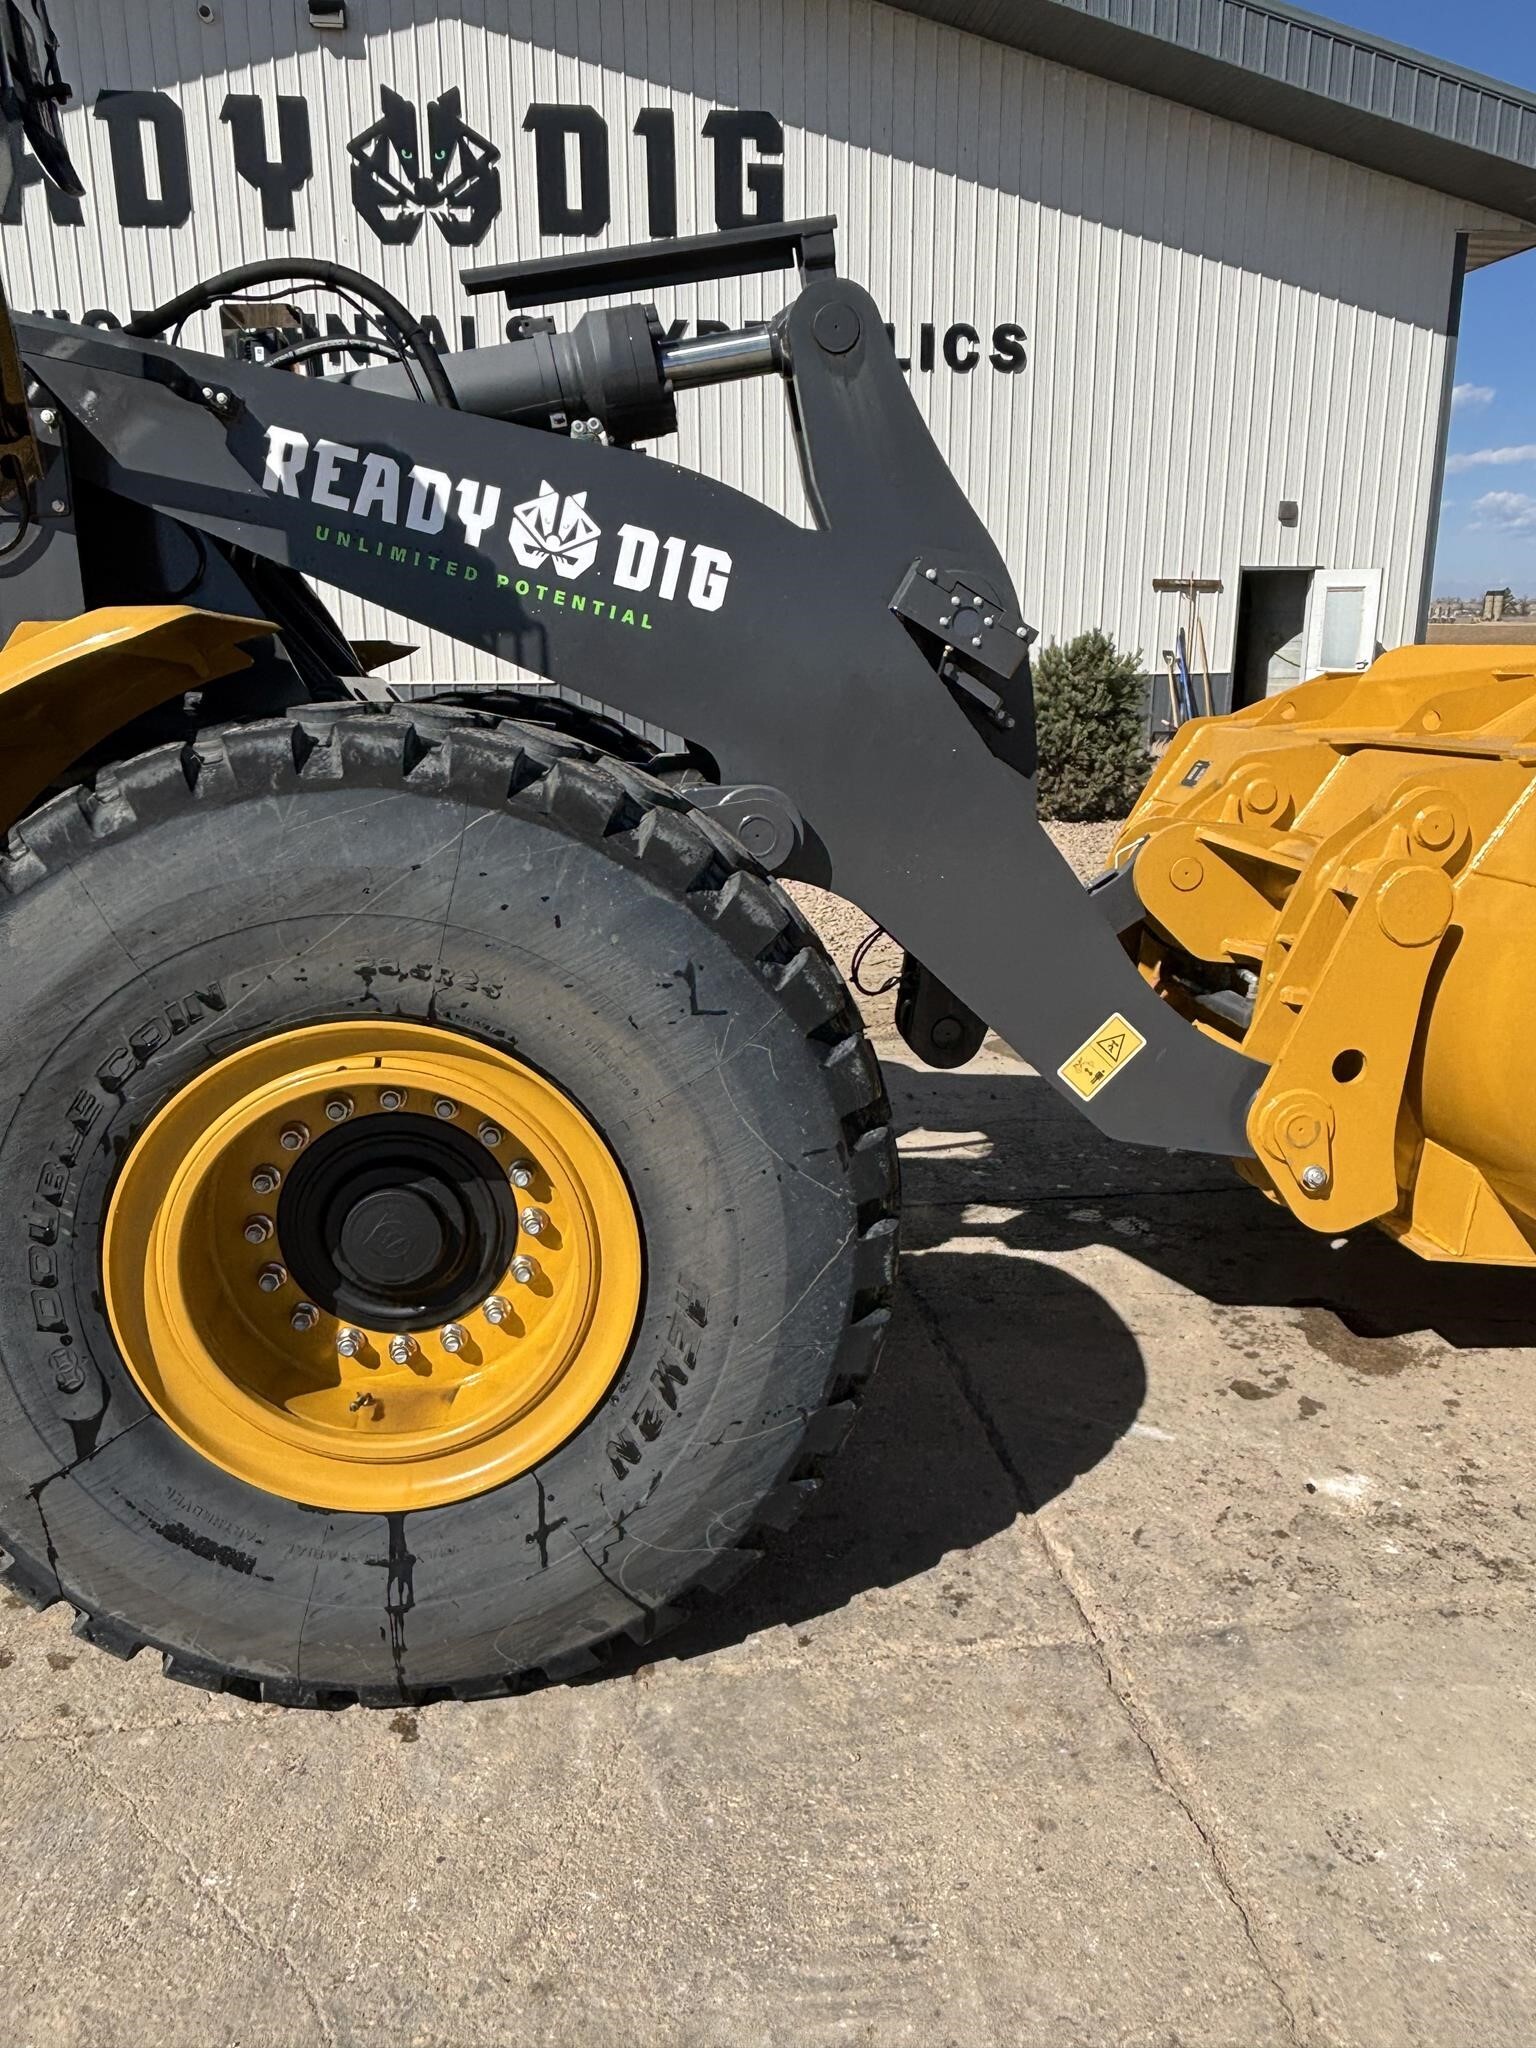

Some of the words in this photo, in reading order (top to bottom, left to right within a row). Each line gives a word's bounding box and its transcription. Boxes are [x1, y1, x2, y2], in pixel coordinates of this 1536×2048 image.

[262, 424, 501, 548] READY
[315, 525, 478, 582] UNLIMITED
[497, 574, 653, 630] POTENTIAL
[28, 1087, 103, 1334] DOUBLE
[97, 980, 229, 1094] COIN
